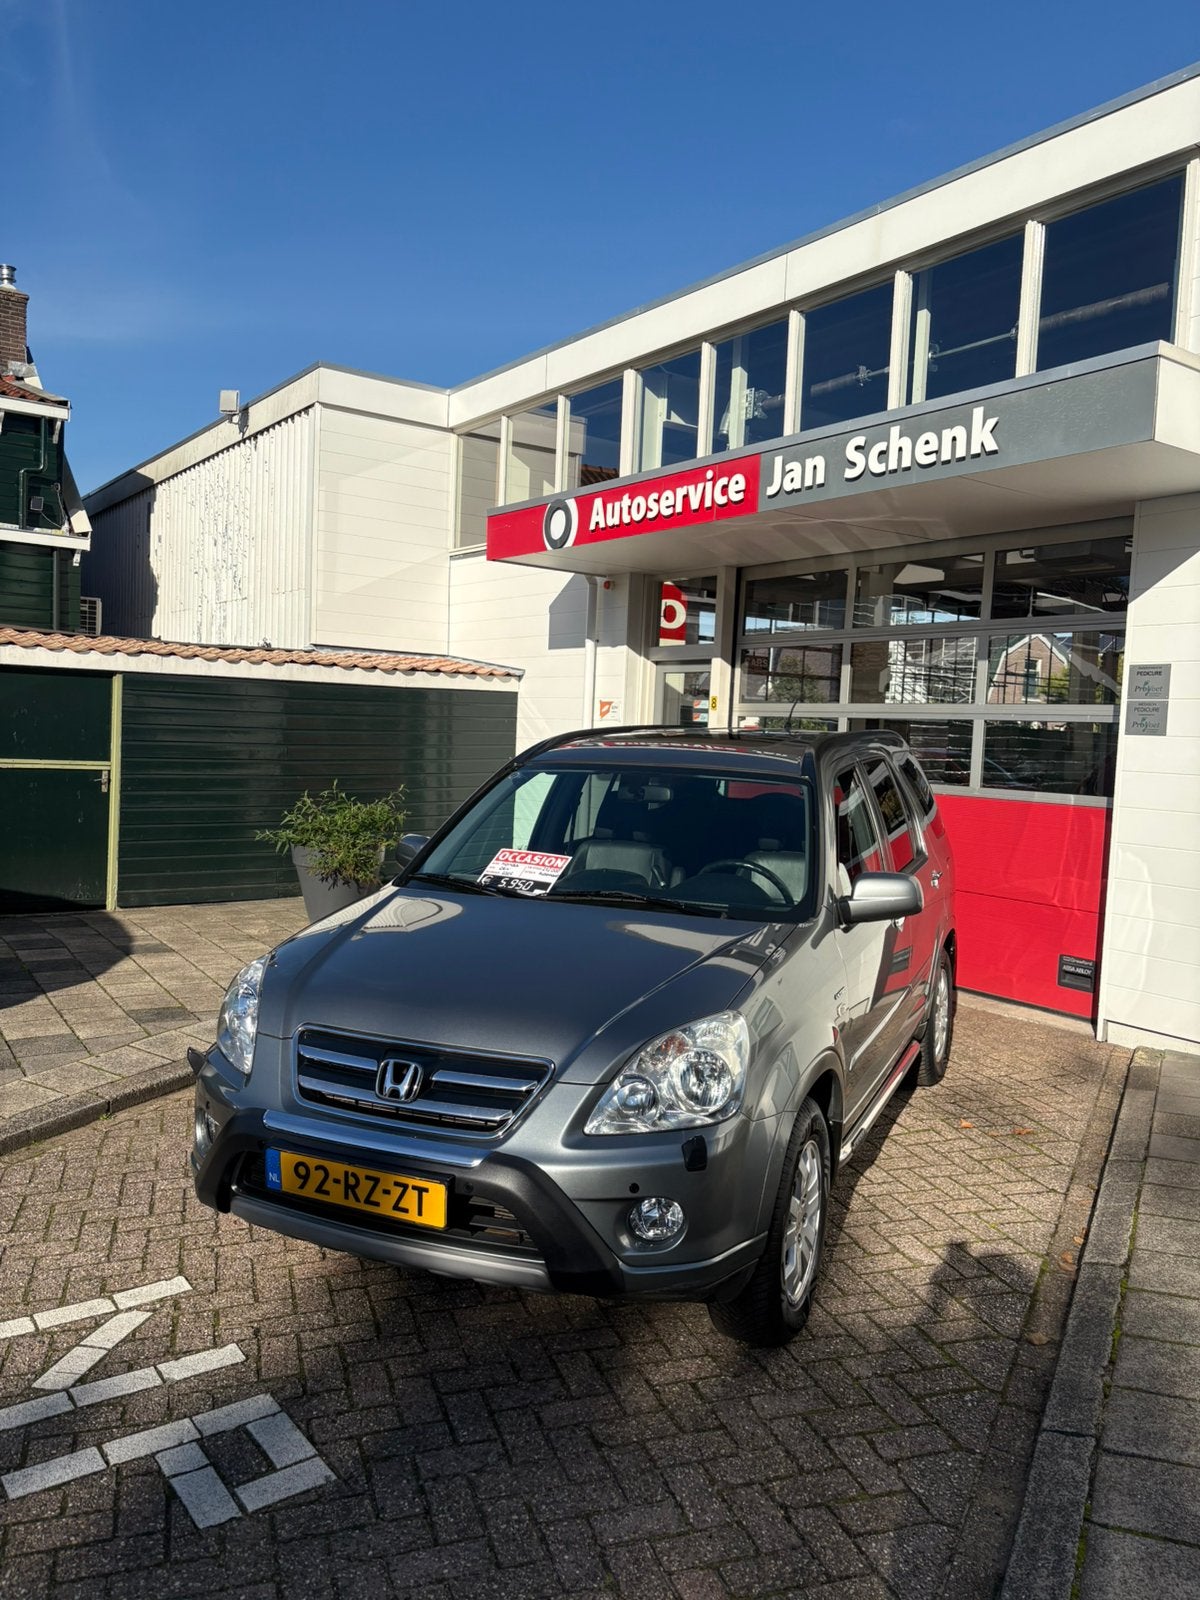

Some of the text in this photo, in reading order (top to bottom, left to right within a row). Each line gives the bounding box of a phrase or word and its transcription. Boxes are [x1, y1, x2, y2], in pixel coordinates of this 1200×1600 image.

[588, 405, 1000, 532] Autoservice Jan Schenk
[498, 851, 567, 868] OCCASION
[498, 877, 534, 891] 5.950
[268, 1172, 280, 1183] NL
[293, 1161, 430, 1217] 92-RZ-ZT
